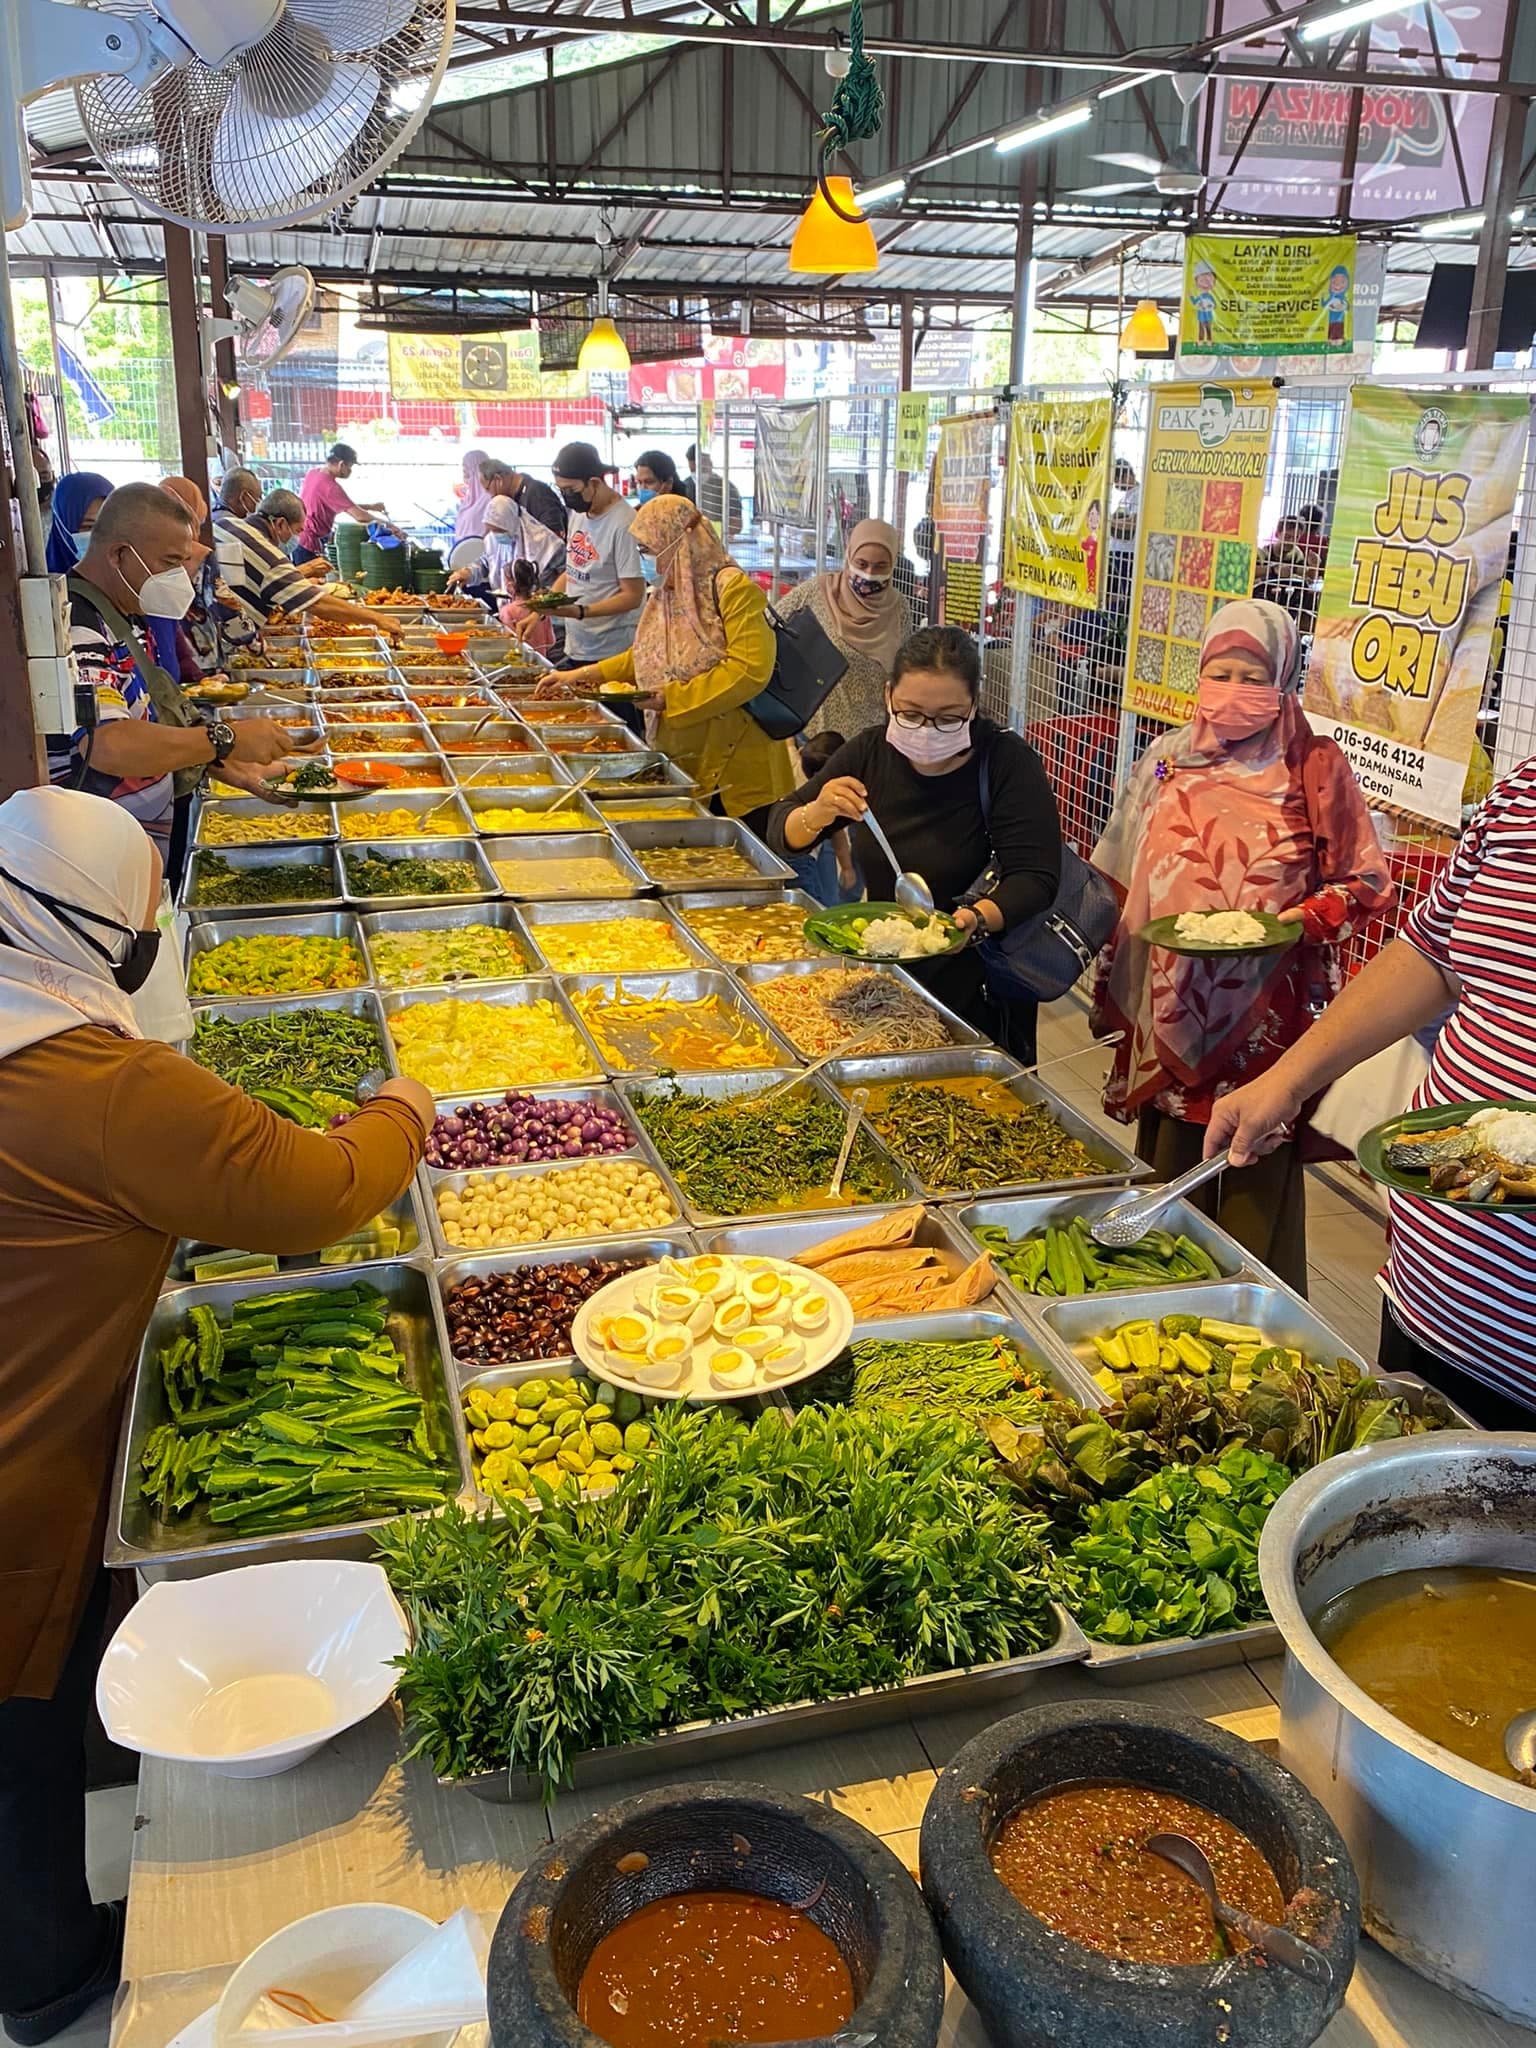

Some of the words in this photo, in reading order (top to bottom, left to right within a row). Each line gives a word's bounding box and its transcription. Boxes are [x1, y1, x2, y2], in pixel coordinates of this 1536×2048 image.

[1234, 244, 1279, 257] LAYAN
[1283, 244, 1312, 257] DIRI
[1220, 299, 1254, 313] SELF
[1257, 299, 1321, 313] SERVICE
[1160, 409, 1198, 429] PAK
[1232, 409, 1267, 430] ALI
[1059, 446, 1101, 468] sendiri
[1152, 449, 1188, 475] JERUK
[1187, 450, 1221, 476] MADU
[1221, 451, 1246, 478] PAK
[1243, 452, 1268, 478] ALI
[1373, 466, 1473, 549] JUS
[1349, 536, 1472, 631] TEBU
[1351, 613, 1442, 699] ORI
[1133, 685, 1180, 719] DIJUAL
[1333, 726, 1389, 759] 016-946
[1391, 747, 1426, 772] 4124
[1359, 756, 1423, 789] DAMANSARA
[1362, 775, 1394, 798] Ceroi
